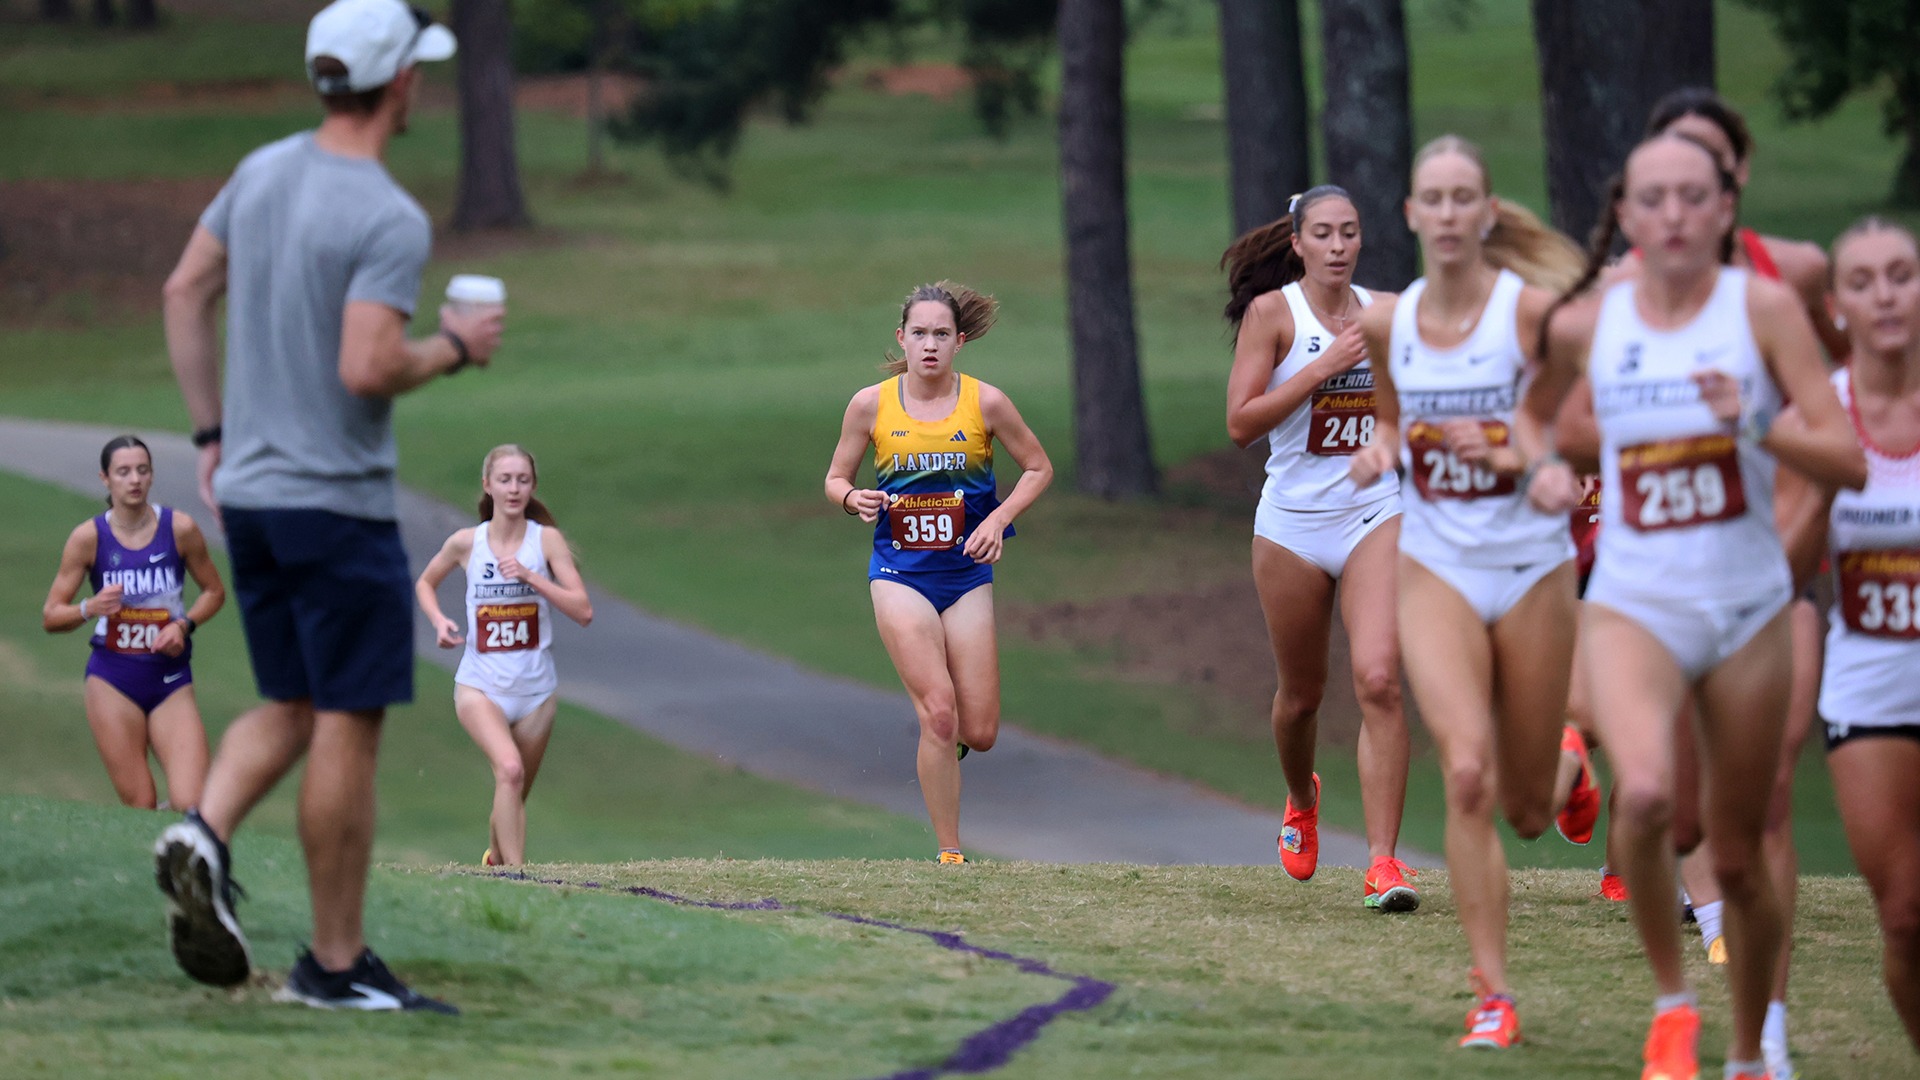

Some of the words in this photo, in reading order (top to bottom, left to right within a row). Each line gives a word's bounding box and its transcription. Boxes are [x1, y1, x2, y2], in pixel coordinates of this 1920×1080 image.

[1322, 414, 1375, 448] 248
[893, 452, 967, 472] LANDER
[1636, 463, 1726, 527] 259
[903, 514, 953, 542] 359
[103, 566, 177, 595] FURMAN
[1858, 581, 1920, 631] 33
[117, 623, 160, 649] 320
[486, 620, 529, 648] 254
